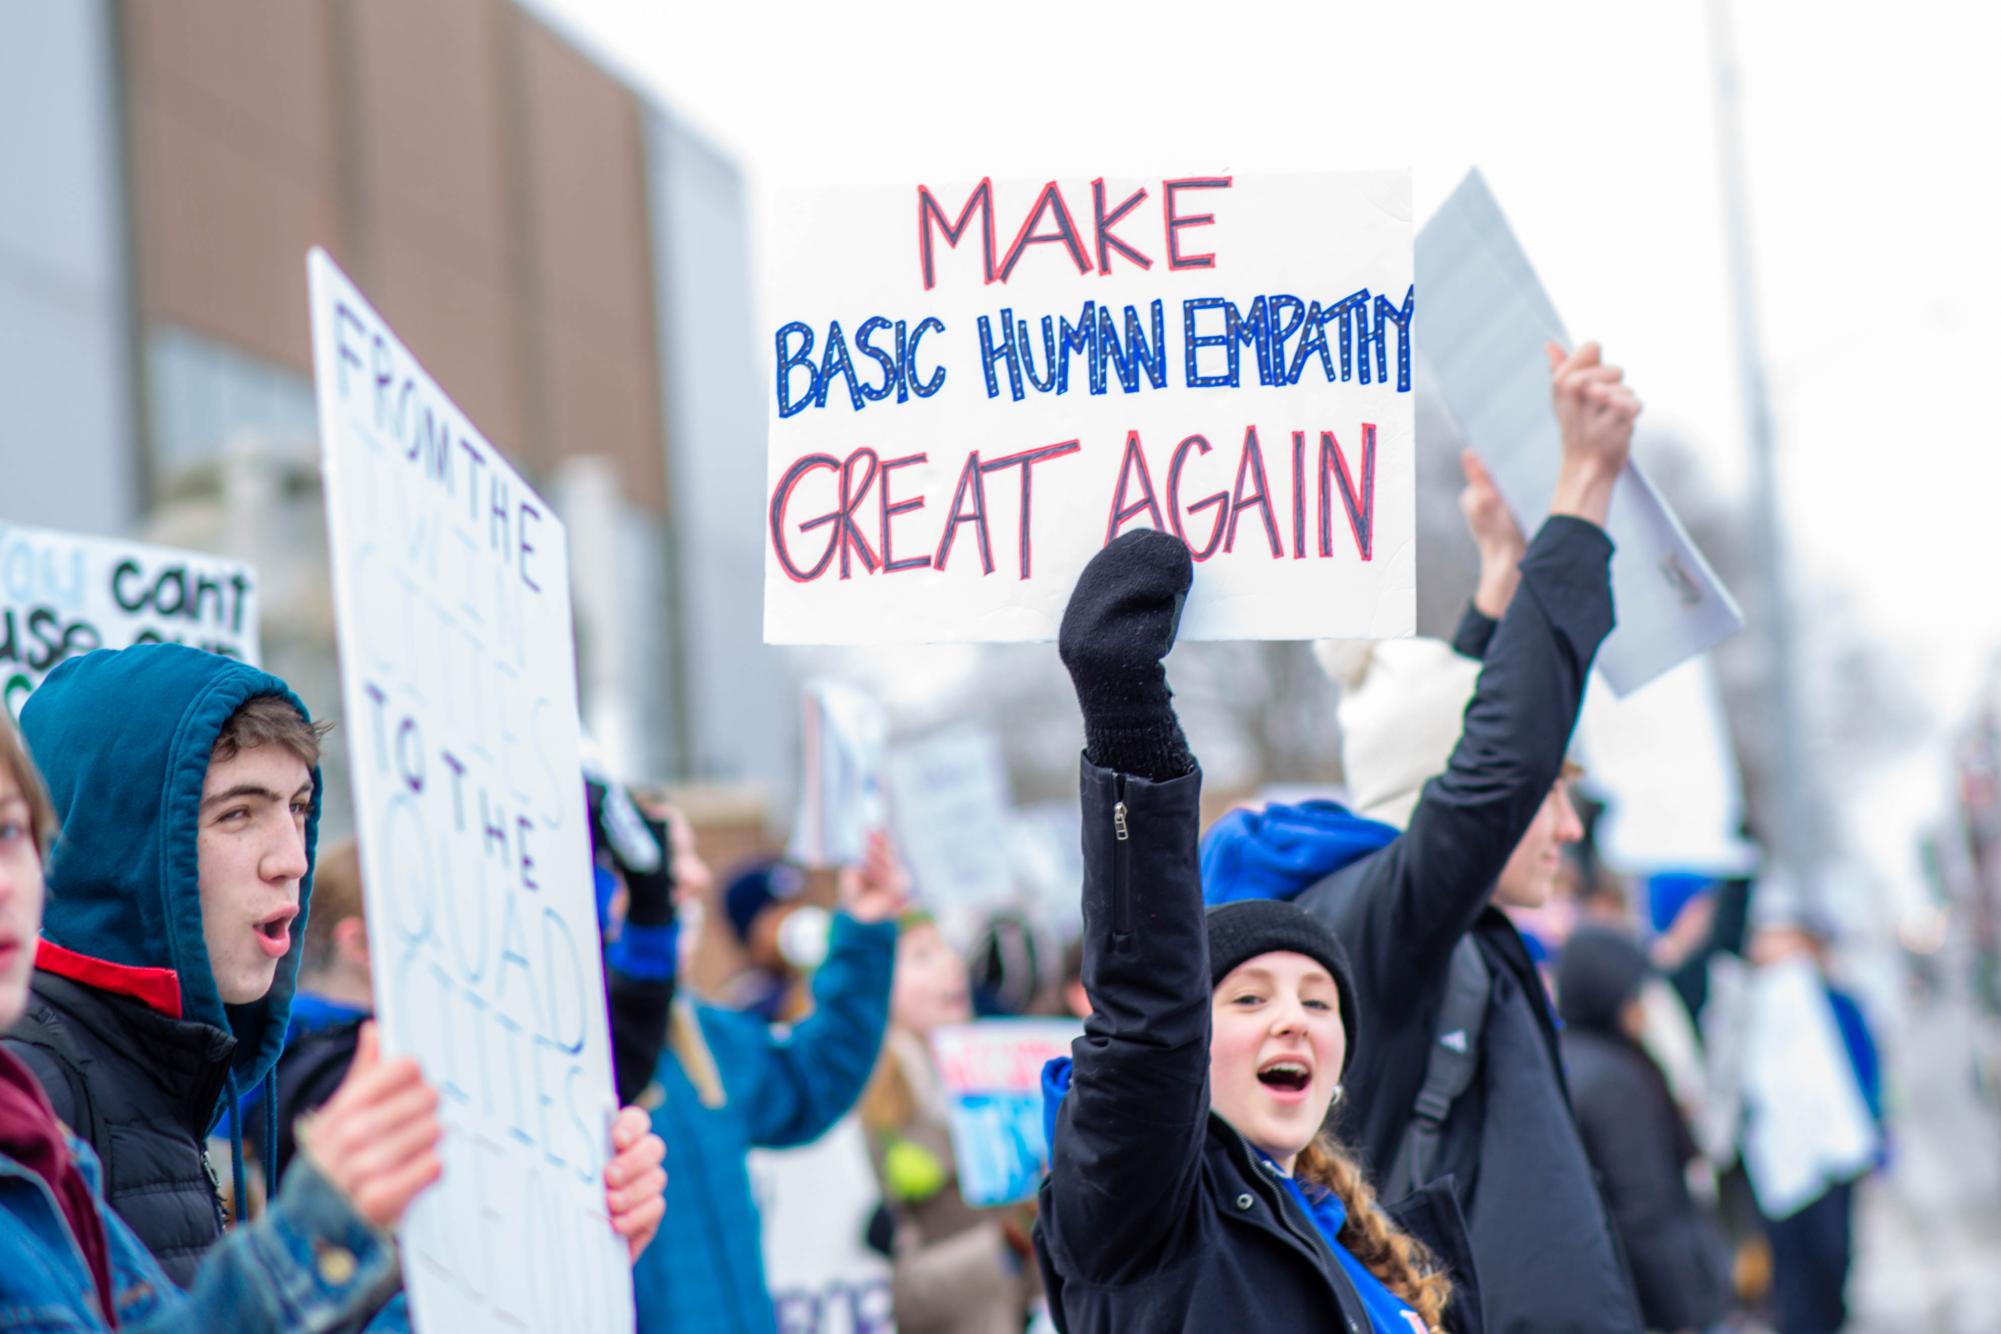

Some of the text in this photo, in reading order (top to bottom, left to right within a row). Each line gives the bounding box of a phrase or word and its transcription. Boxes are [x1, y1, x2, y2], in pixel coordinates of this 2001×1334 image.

[917, 177, 1233, 290] MAKE
[775, 284, 1414, 418] BASIC HUMAN EMPATHY
[334, 301, 542, 595] FROM THE
[770, 422, 1377, 583] GREAT AGAIN
[0, 538, 250, 635] ou cant
[365, 681, 540, 892] TO THE
[383, 790, 588, 1056] QUAD
